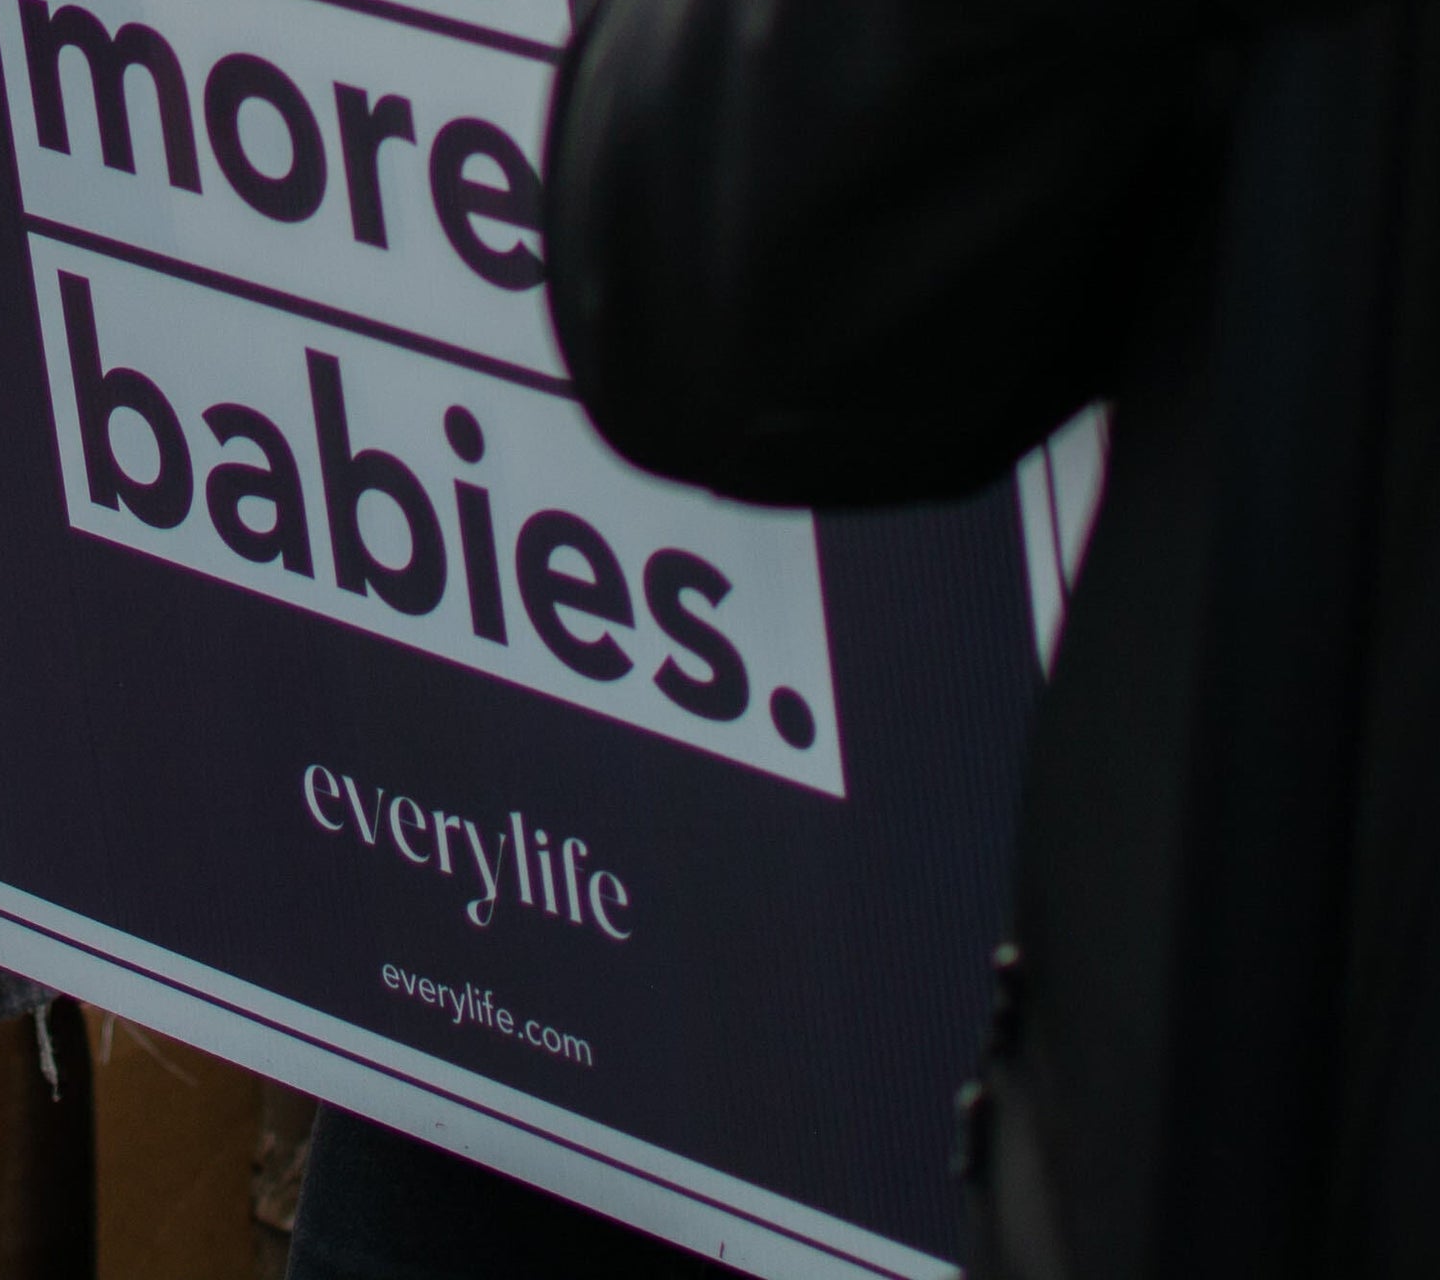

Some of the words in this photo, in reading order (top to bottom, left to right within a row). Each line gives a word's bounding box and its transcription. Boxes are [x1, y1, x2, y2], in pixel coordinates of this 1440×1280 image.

[56, 267, 818, 751] babies.
[303, 763, 632, 940] everylife
[381, 962, 594, 1067] everylife.com
